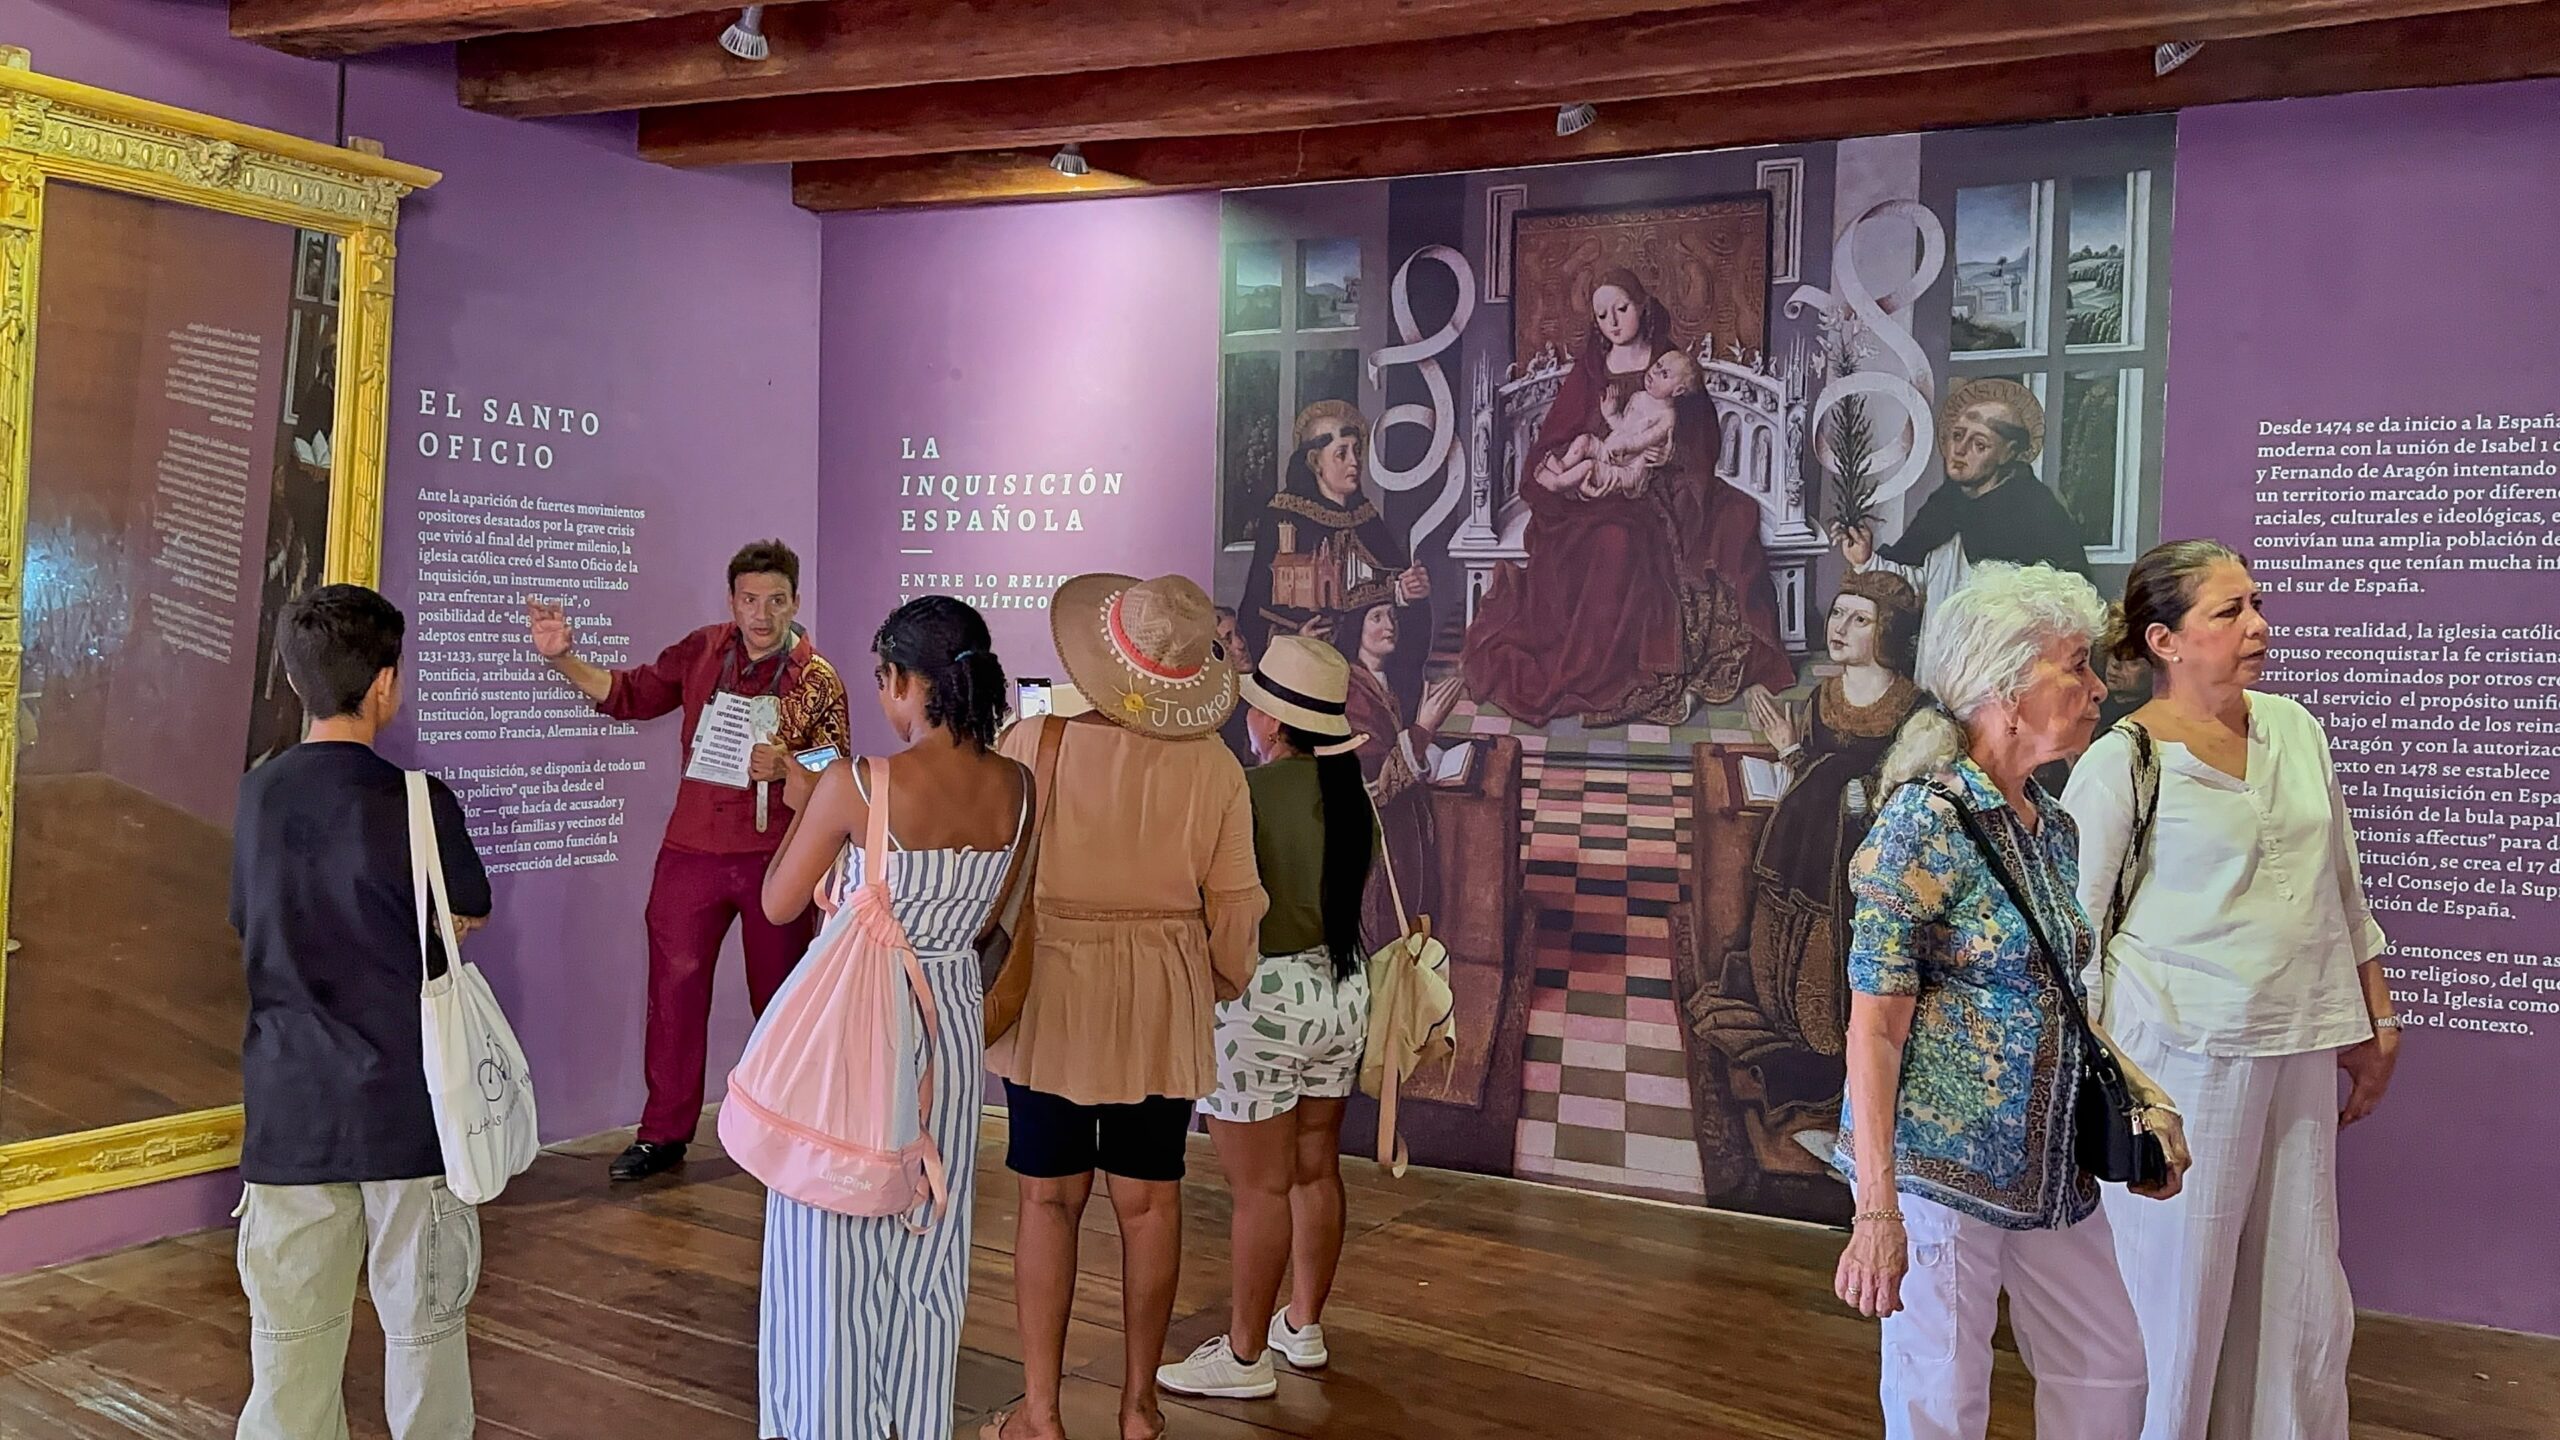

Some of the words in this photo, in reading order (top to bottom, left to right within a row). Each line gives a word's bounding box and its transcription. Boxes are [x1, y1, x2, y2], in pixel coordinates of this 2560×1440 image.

[419, 389, 461, 418] EL
[483, 398, 599, 435] SANTO
[2259, 419, 2312, 435] Desde
[2316, 422, 2352, 435] 1474
[2404, 416, 2457, 432] inicio
[2476, 414, 2492, 430] la
[418, 432, 553, 469] OFICIO
[901, 437, 940, 459] LA
[2258, 442, 2336, 457] moderna
[2340, 445, 2372, 456] con
[2396, 439, 2449, 454] unión
[2481, 436, 2536, 453] Isabel
[2270, 463, 2353, 480] Fernando
[2382, 462, 2448, 482] Aragón
[2453, 460, 2556, 476] intentando
[900, 468, 1123, 501] INQUISICIÓN
[2282, 486, 2365, 502] territorio
[2370, 484, 2448, 501] marcado
[2453, 489, 2485, 504] por
[418, 488, 447, 502] Ante
[462, 493, 518, 508] aparición
[536, 497, 575, 513] fuertes
[577, 504, 645, 519] movimientos
[418, 509, 481, 525] opositores
[484, 512, 540, 529] desatados
[543, 521, 562, 533] por
[576, 524, 605, 536] grave
[607, 524, 635, 537] crisis
[901, 504, 1084, 531] ESPAÑOLA
[2255, 509, 2326, 527] raciales,
[2331, 508, 2418, 524] culturales
[2438, 507, 2545, 527] ideológicas,
[418, 531, 440, 544] que
[443, 530, 472, 543] vivió
[488, 532, 514, 546] final
[516, 534, 534, 548] del
[536, 536, 574, 552] primer
[577, 539, 620, 555] milenio,
[2254, 532, 2337, 547] convivían
[2342, 536, 2375, 547] una
[2379, 532, 2441, 551] amplia
[2446, 531, 2536, 550] población
[419, 548, 458, 564] iglesia
[461, 551, 506, 565] católica
[508, 554, 533, 567] creó
[547, 556, 578, 569] Santo
[580, 558, 613, 572] Oficio
[2253, 554, 2364, 570] musulmanes
[2369, 559, 2401, 574] que
[2406, 554, 2464, 570] tenían
[2469, 554, 2532, 569] mucha
[419, 568, 491, 585] Inquisición,
[511, 572, 580, 588] instrumento
[582, 576, 628, 590] utilizado
[901, 574, 964, 587] ENTRE
[975, 575, 998, 588] LO
[2296, 582, 2324, 592] sur
[2354, 578, 2425, 596] España.
[418, 592, 446, 604] para
[448, 589, 505, 604] enfrentar
[418, 608, 485, 625] posibilidad
[574, 613, 612, 629] ganaba
[418, 628, 465, 645] adeptos
[468, 632, 499, 642] entre
[502, 634, 520, 643] sus
[580, 632, 600, 646] Así,
[603, 636, 630, 645] entre
[2295, 626, 2330, 637] esta
[2334, 622, 2412, 640] realidad,
[2438, 623, 2497, 643] iglesia
[418, 651, 475, 663] 1231-1233,
[478, 653, 510, 665] surge
[590, 650, 618, 666] Papal
[2326, 646, 2439, 664] reconquistar
[419, 668, 480, 682] Pontificia,
[482, 668, 536, 681] atribuida
[2344, 668, 2443, 684] dominados
[2448, 674, 2480, 689] por
[2485, 674, 2532, 686] otros
[431, 687, 479, 701] confirió
[481, 690, 530, 700] sustento
[532, 687, 575, 703] jurídico
[2323, 691, 2392, 706] servicio
[2420, 693, 2508, 712] propósito
[418, 707, 488, 721] Institución,
[490, 706, 542, 723] logrando
[2330, 712, 2367, 732] bajo
[2392, 715, 2454, 730] mando
[2485, 716, 2511, 732] los
[418, 728, 462, 744] lugares
[464, 730, 496, 740] como
[500, 725, 545, 739] Francia,
[547, 724, 598, 737] Alemania
[609, 722, 638, 735] Italia.
[2328, 736, 2393, 756] Aragón
[2416, 742, 2448, 753] con
[2452, 738, 2469, 754] la
[459, 764, 528, 782] Inquisición,
[544, 761, 592, 778] disponía
[608, 758, 631, 772] todo
[2401, 763, 2437, 777] 1478
[2442, 766, 2461, 776] se
[2466, 763, 2550, 780] establece
[519, 785, 540, 798] que
[542, 780, 559, 794] iba
[561, 778, 593, 792] desde
[2383, 783, 2485, 802] Inquisición
[2491, 791, 2512, 802] en
[499, 806, 519, 818] que
[522, 800, 552, 814] hacía
[569, 796, 617, 810] acusador
[493, 822, 508, 834] las
[511, 818, 556, 833] familias
[566, 816, 606, 829] vecinos
[608, 812, 623, 826] del
[2418, 806, 2440, 822] de
[2466, 808, 2505, 824] bula
[2510, 812, 2560, 830] papal
[495, 840, 531, 854] tenían
[534, 840, 564, 850] como
[566, 833, 607, 847] función
[2416, 829, 2496, 847] affectus”
[2500, 838, 2542, 852] para
[485, 856, 553, 878] persecución
[554, 853, 572, 867] del
[574, 850, 619, 865] acusado.
[2463, 859, 2502, 871] crea
[2506, 856, 2522, 872] el
[2527, 862, 2544, 875] 17
[2378, 872, 2392, 887] el
[2398, 875, 2469, 895] Consejo
[2474, 878, 2495, 894] de
[2417, 897, 2438, 913] de
[2444, 900, 2516, 919] España.
[2401, 946, 2481, 962] entonces
[2486, 952, 2508, 964] en
[2411, 966, 2496, 988] religioso,
[2500, 971, 2527, 988] del
[2444, 991, 2504, 1010] Iglesia
[2508, 1000, 2559, 1013] como
[2429, 1012, 2444, 1027] el
[2449, 1018, 2534, 1035] contexto.
